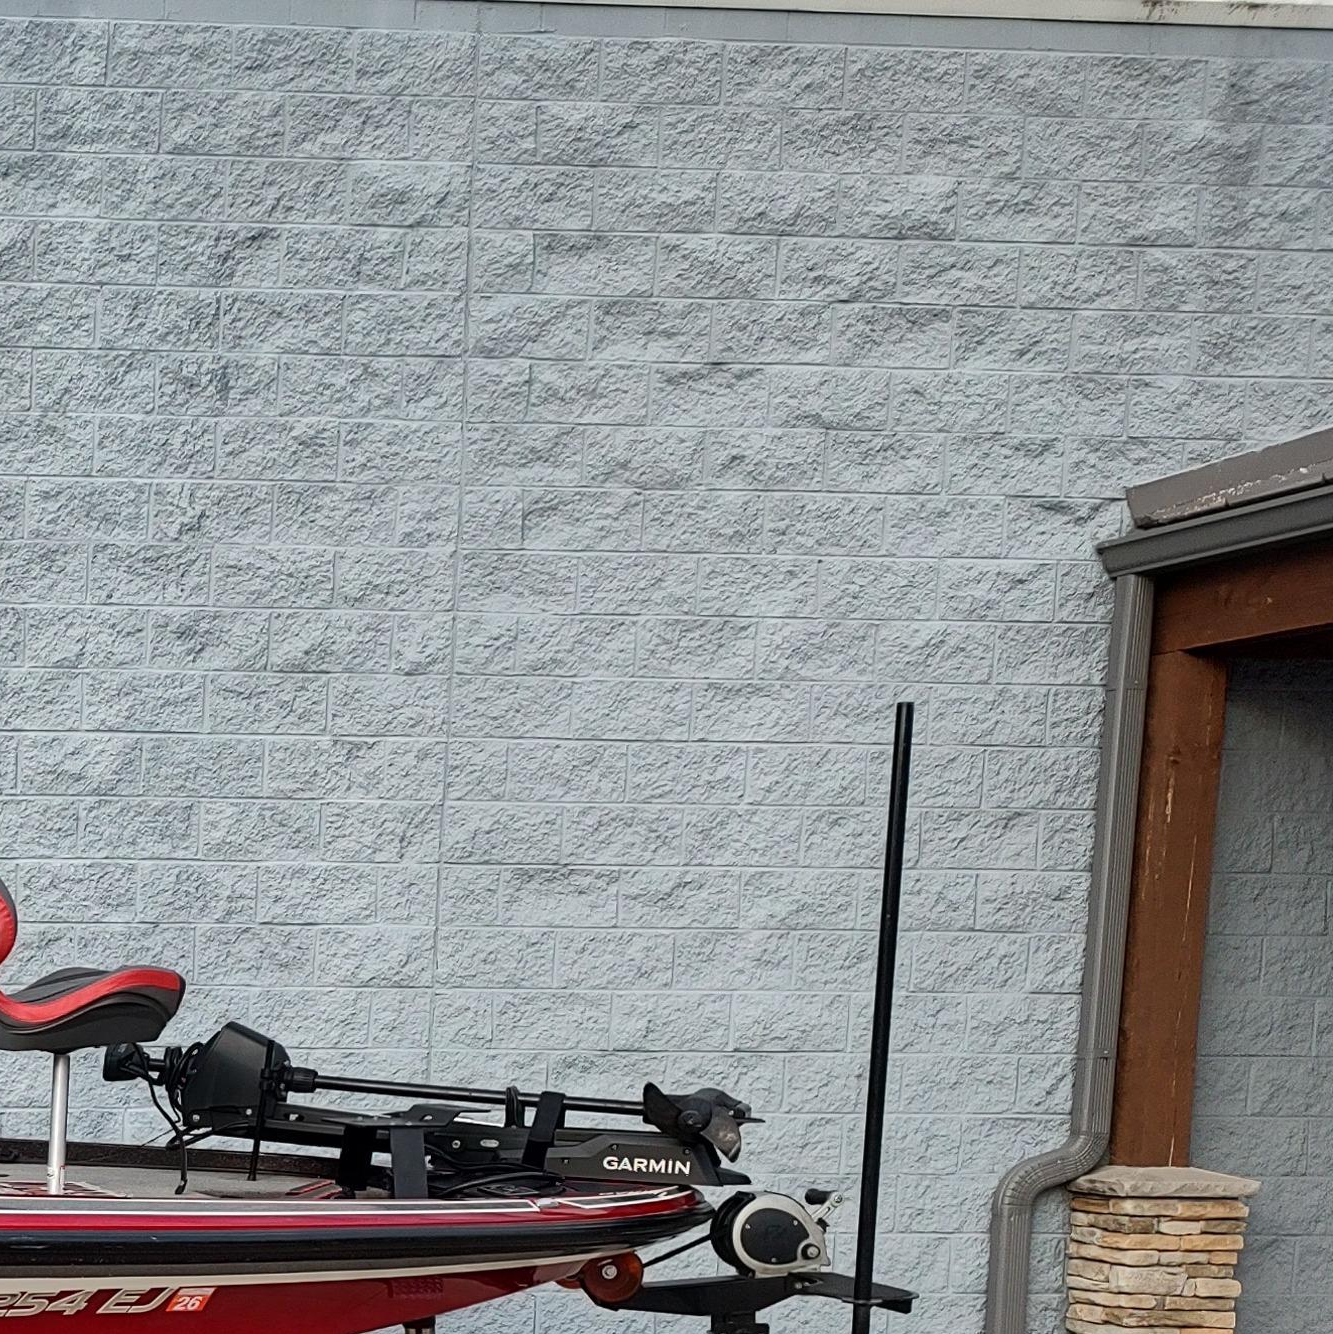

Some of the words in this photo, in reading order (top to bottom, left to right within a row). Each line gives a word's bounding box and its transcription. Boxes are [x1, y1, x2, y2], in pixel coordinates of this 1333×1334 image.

[602, 1156, 691, 1175] GARMIN
[95, 1286, 176, 1314] EJ
[176, 1296, 201, 1312] 26
